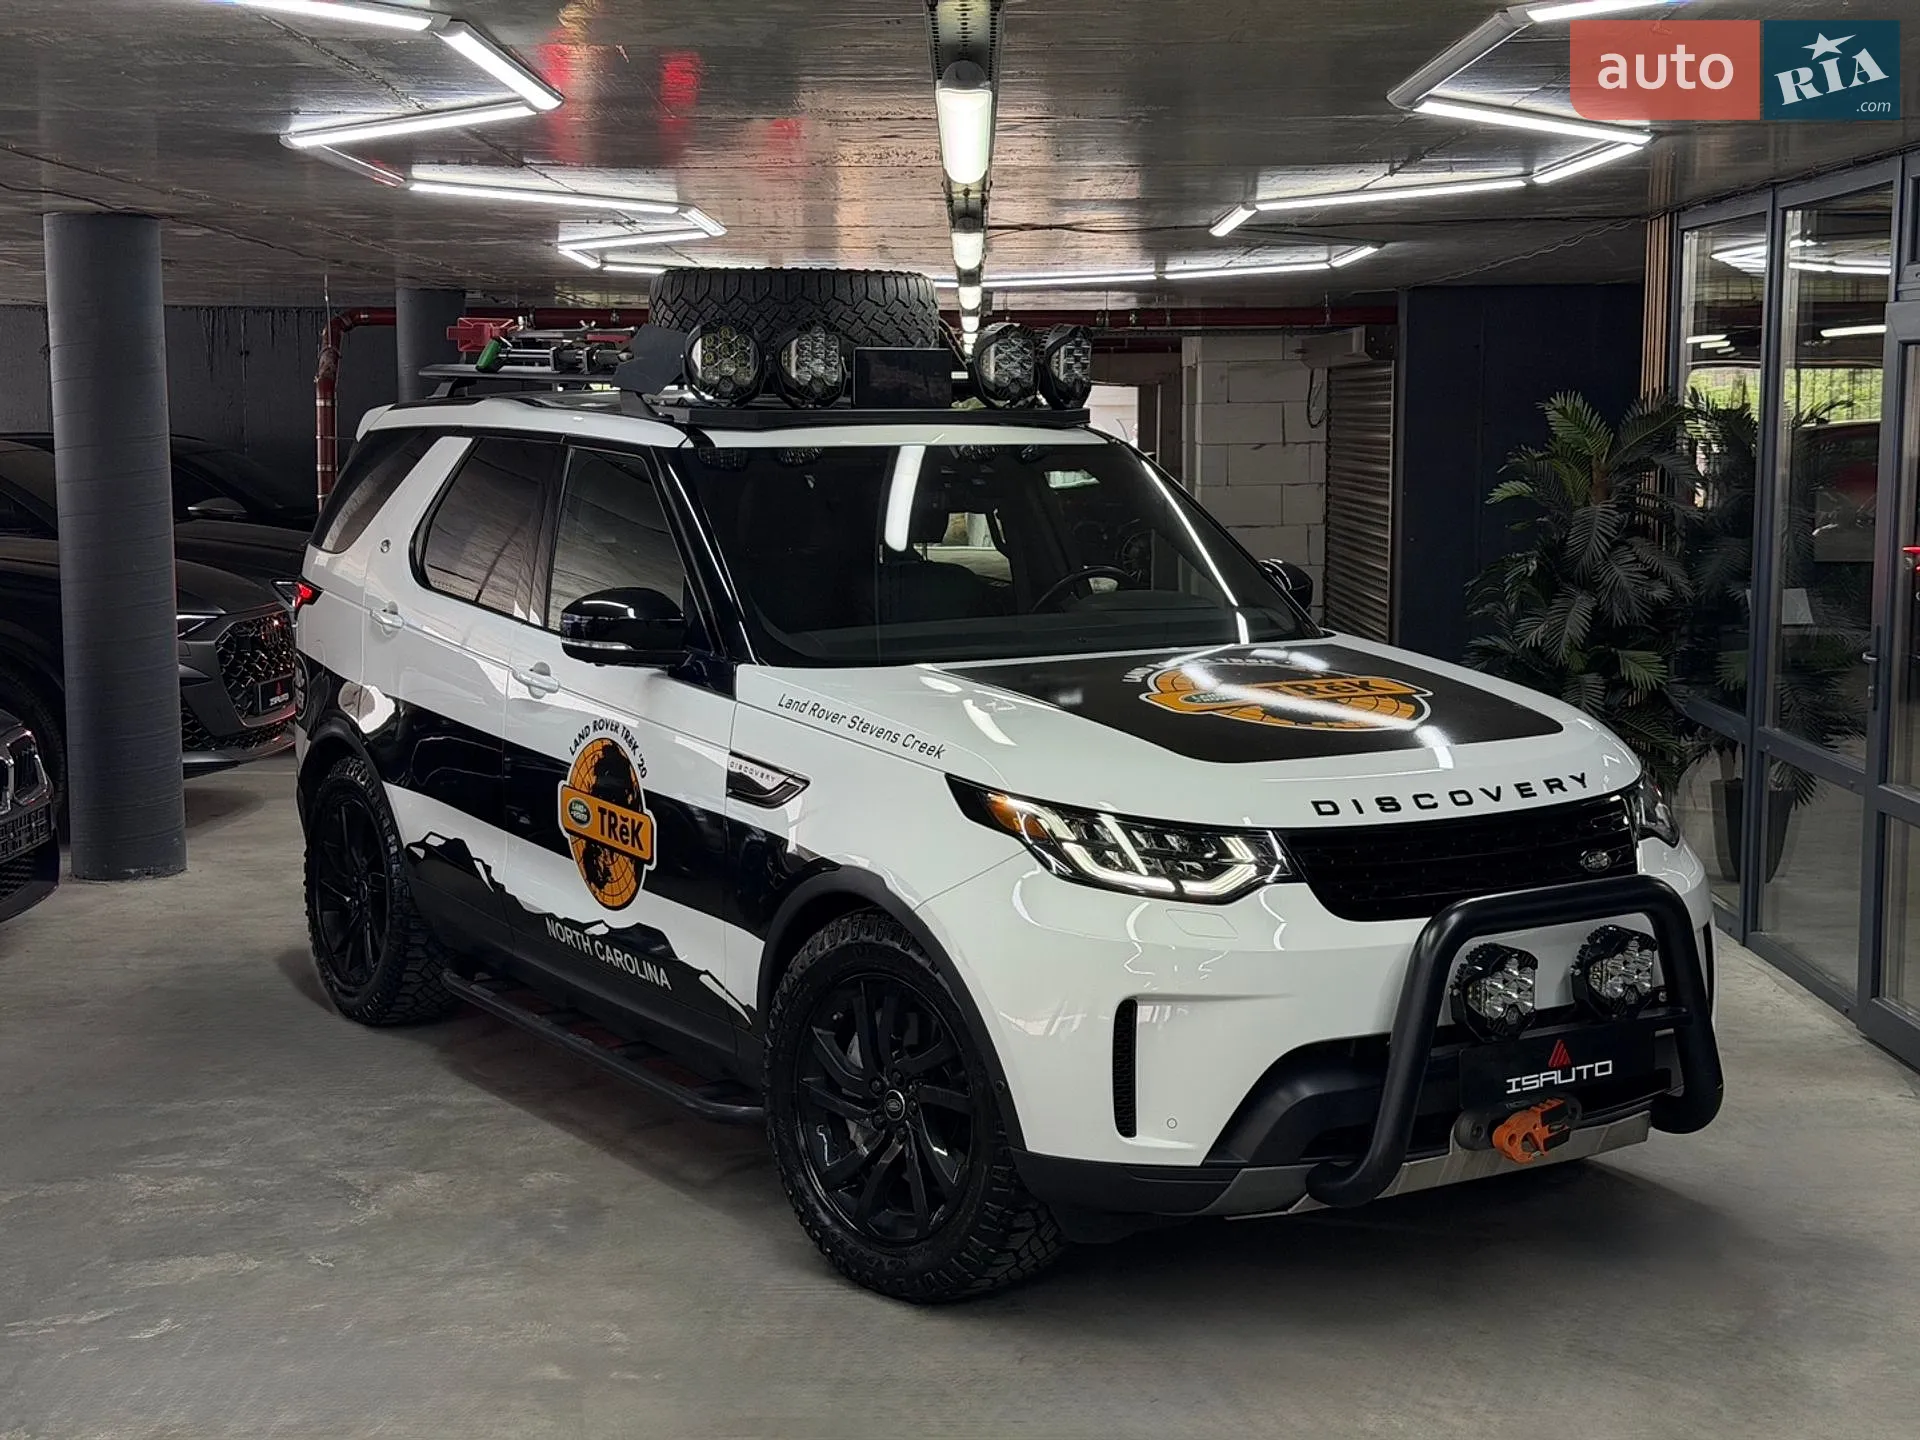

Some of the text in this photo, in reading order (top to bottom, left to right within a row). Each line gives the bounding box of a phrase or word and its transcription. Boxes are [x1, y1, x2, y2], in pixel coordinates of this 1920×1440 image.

[569, 725, 591, 756] LAND
[592, 719, 620, 734] ROVER
[778, 693, 947, 760] Land Rover Stevens Creek
[730, 761, 776, 782] DISCOVERY
[1311, 772, 1589, 816] DISCOVERY
[545, 917, 672, 991] NORTH CAROLINA
[1506, 1060, 1613, 1094] ISAUTO
